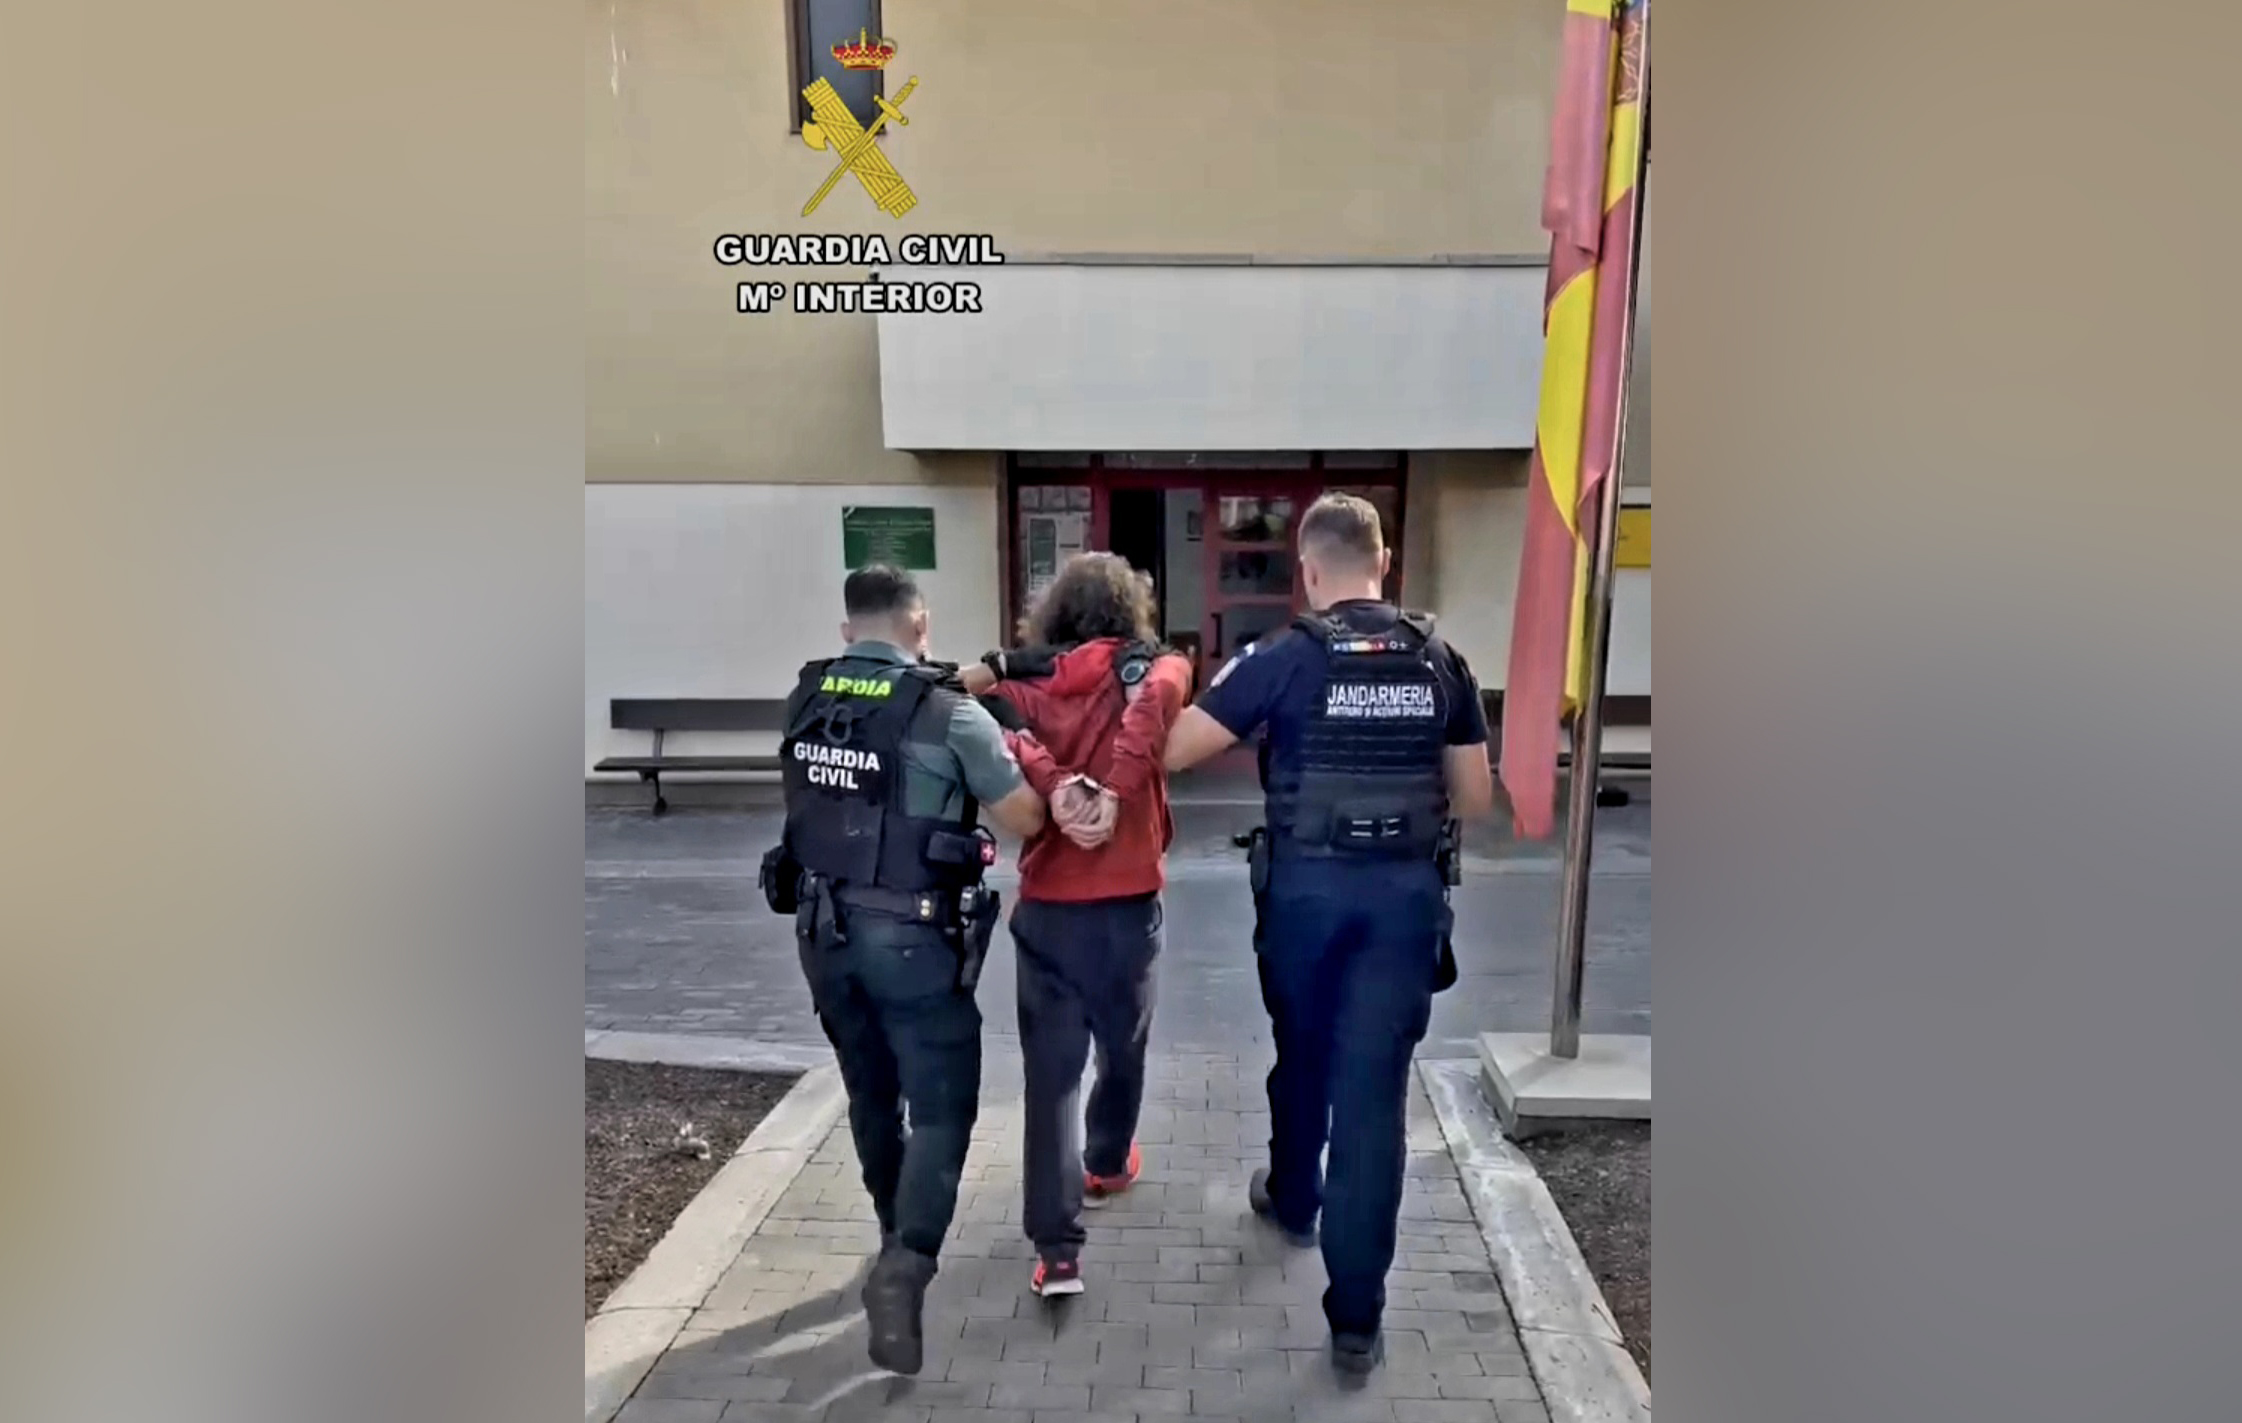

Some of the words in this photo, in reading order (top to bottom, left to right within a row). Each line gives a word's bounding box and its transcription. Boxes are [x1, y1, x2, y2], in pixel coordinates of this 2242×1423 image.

[820, 676, 891, 697] ARDIA
[1327, 684, 1434, 706] JANDARMERIA
[794, 742, 880, 771] GUARDIA
[808, 765, 859, 790] CIVIL
